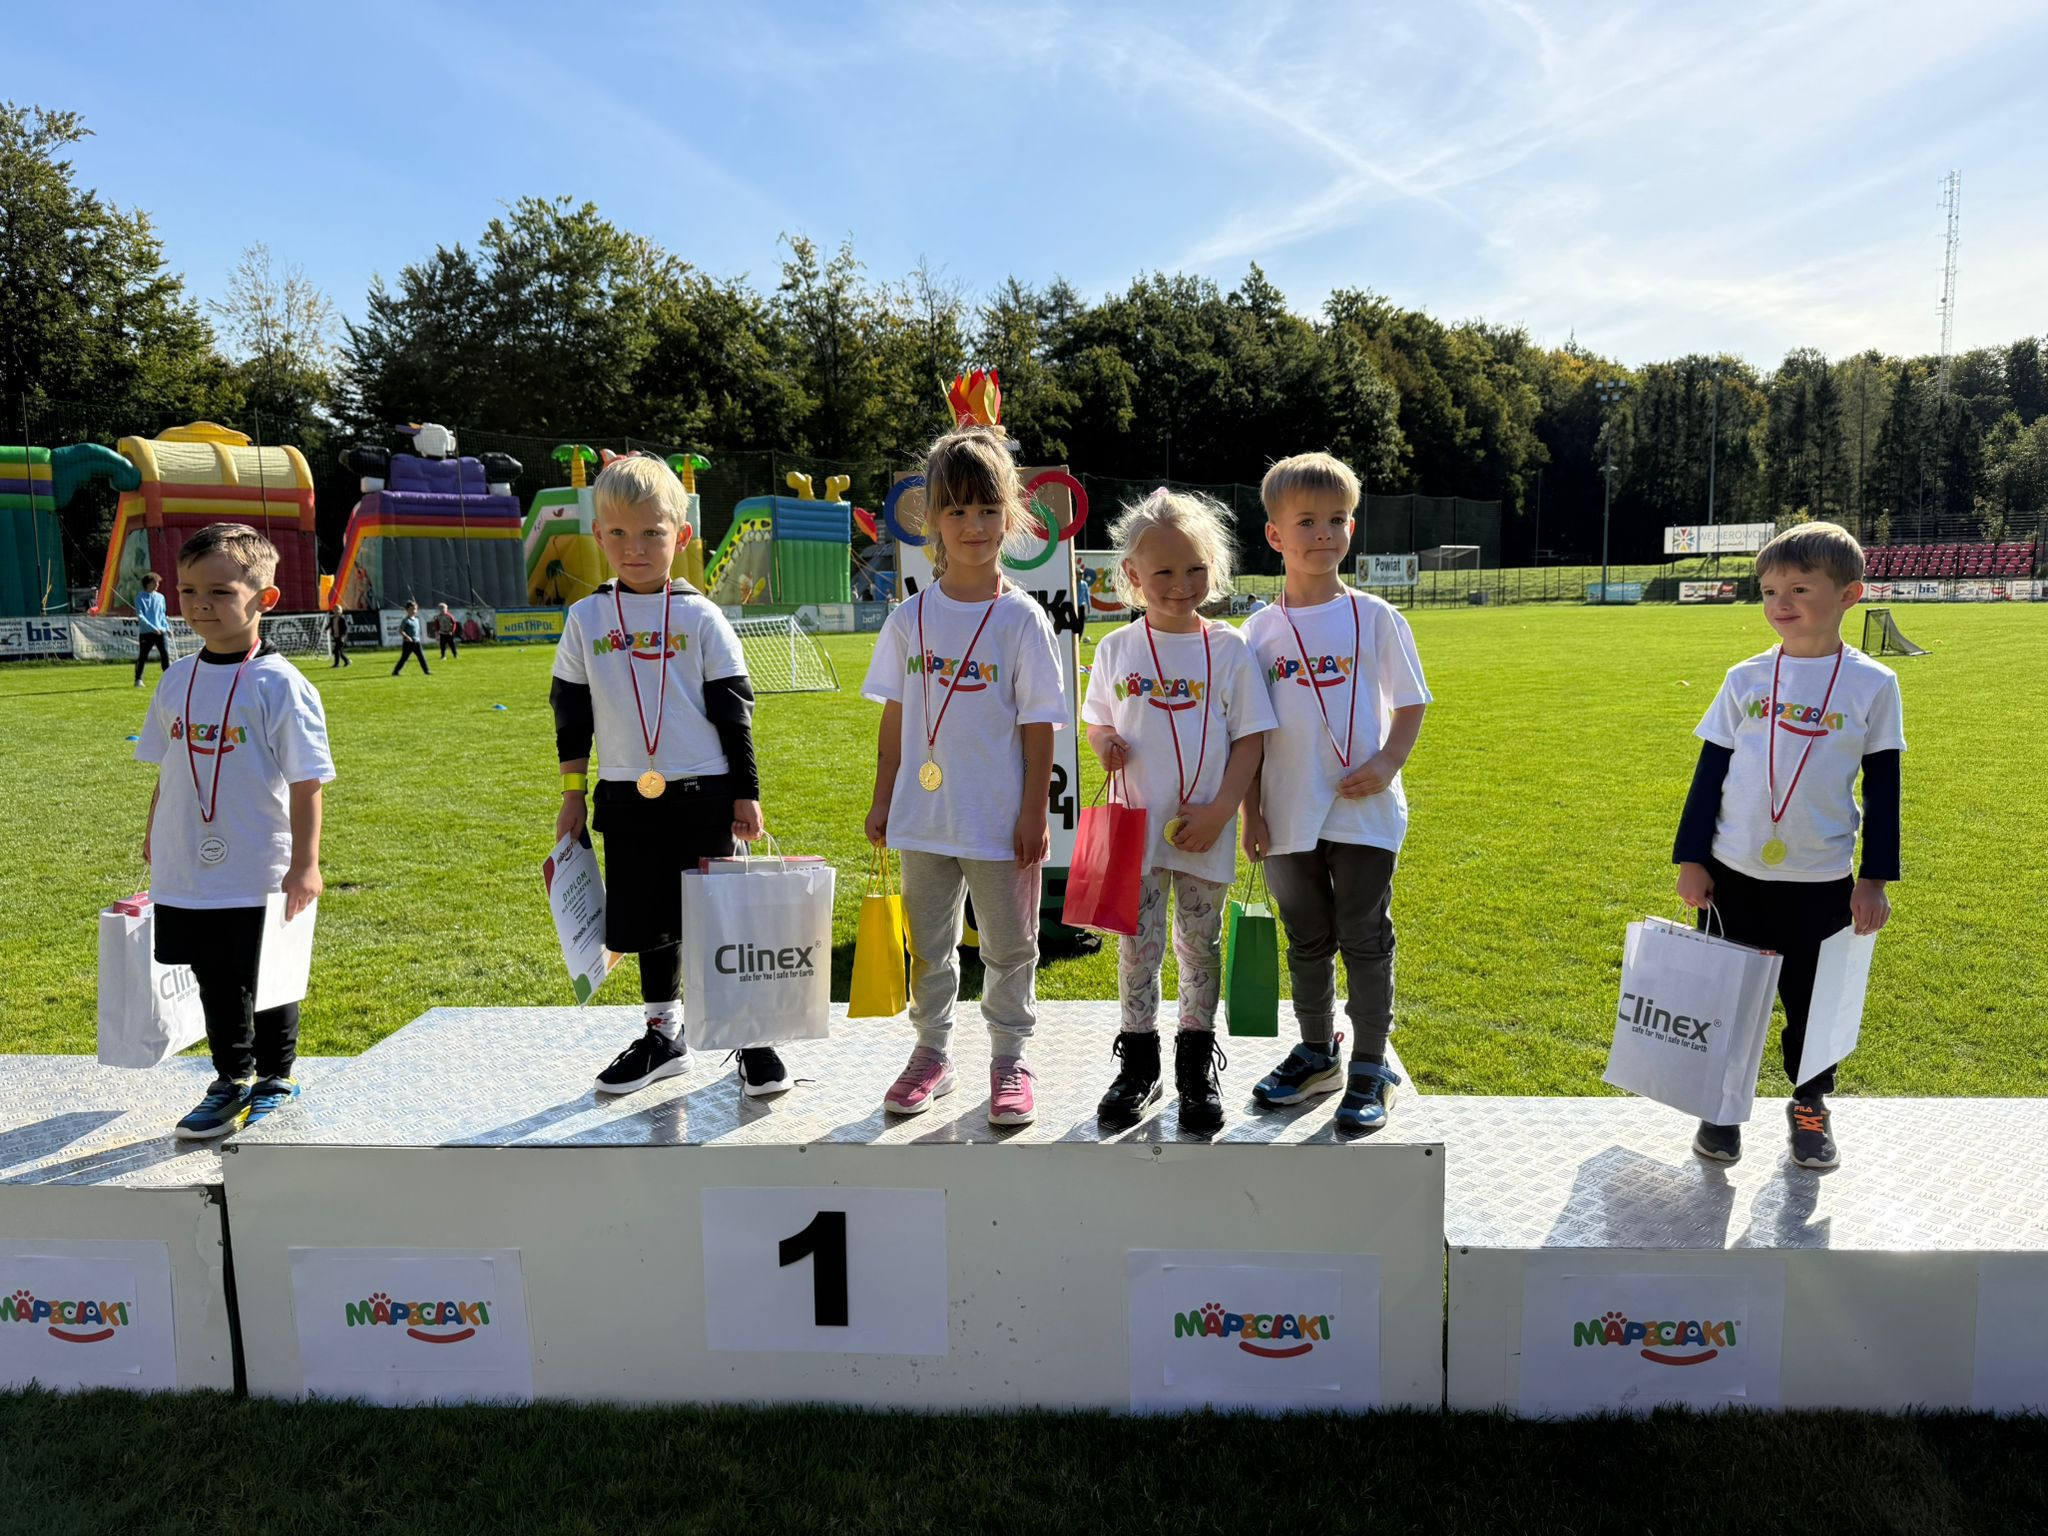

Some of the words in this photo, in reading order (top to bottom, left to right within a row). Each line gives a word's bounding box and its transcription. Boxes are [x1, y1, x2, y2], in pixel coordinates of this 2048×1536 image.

[1375, 558, 1401, 572] Powiat
[26, 621, 68, 642] bis
[504, 620, 554, 632] NORTHPOL
[1114, 673, 1205, 702] MAPECIAK
[563, 869, 588, 902] DYPLOM
[714, 943, 814, 975] Clinex
[160, 966, 197, 1000] Clin
[1618, 992, 1712, 1044] Clinex
[1632, 1025, 1645, 1035] safe
[1691, 1041, 1708, 1053] Earth
[1794, 1105, 1813, 1113] FILA
[778, 1211, 848, 1327] 1
[345, 1294, 490, 1328] MAPECIAKI
[1174, 1303, 1331, 1341] MAPECIAKI
[1573, 1312, 1737, 1348] MAPECIAKI
